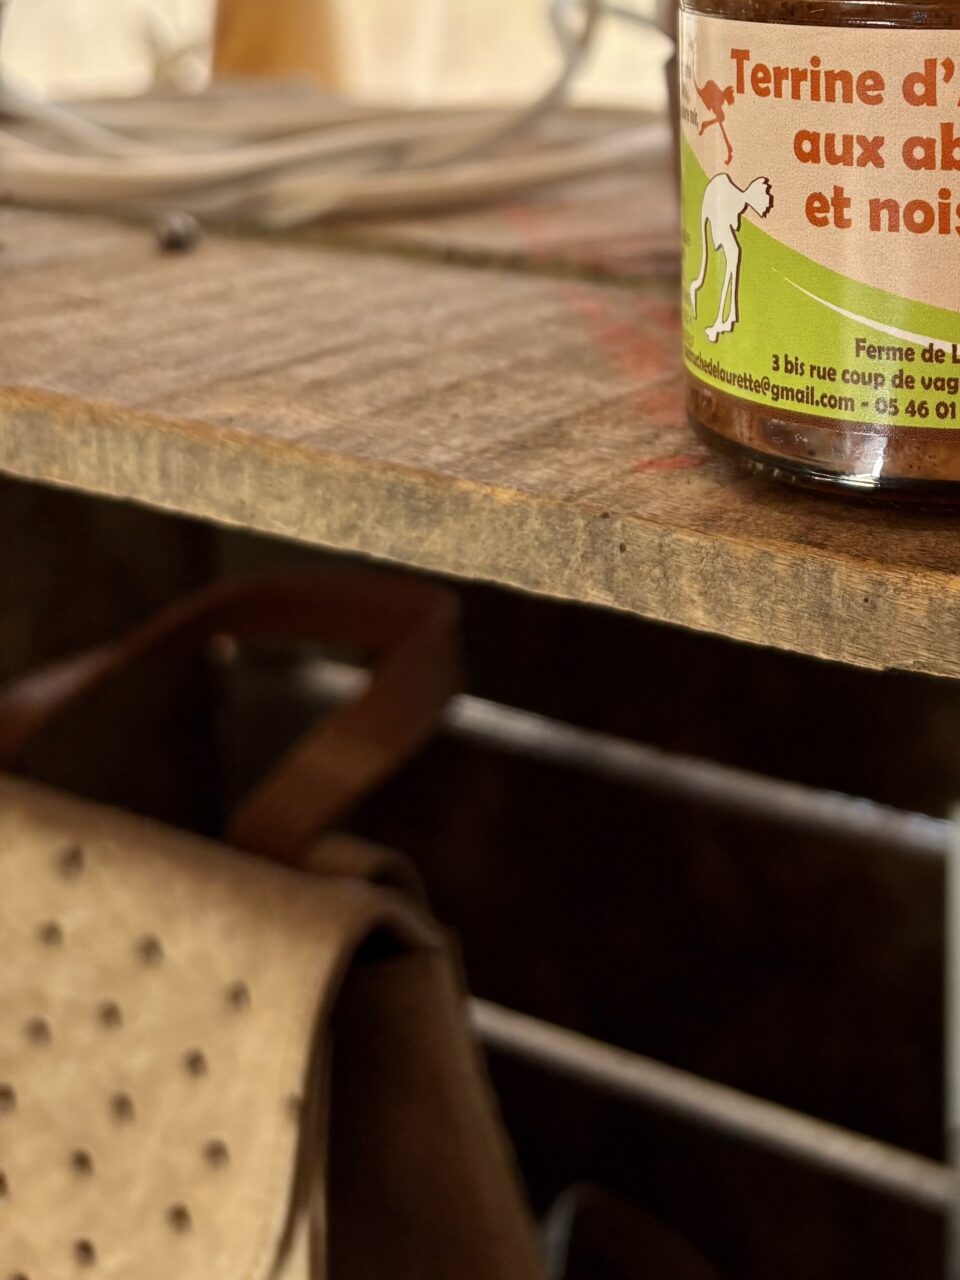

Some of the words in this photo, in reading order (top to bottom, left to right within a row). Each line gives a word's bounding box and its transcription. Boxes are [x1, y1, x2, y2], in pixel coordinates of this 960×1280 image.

[730, 48, 886, 106] Terrine
[793, 129, 885, 168] aux
[805, 185, 852, 229] et
[855, 338, 916, 363] Ferme
[921, 343, 946, 363] de
[771, 353, 780, 372] 3
[784, 354, 805, 377] bis
[809, 362, 837, 383] rue
[841, 366, 886, 389] coup
[891, 369, 915, 390] de
[874, 397, 899, 417] 05
[904, 399, 929, 420] 46
[935, 401, 957, 421] 01
